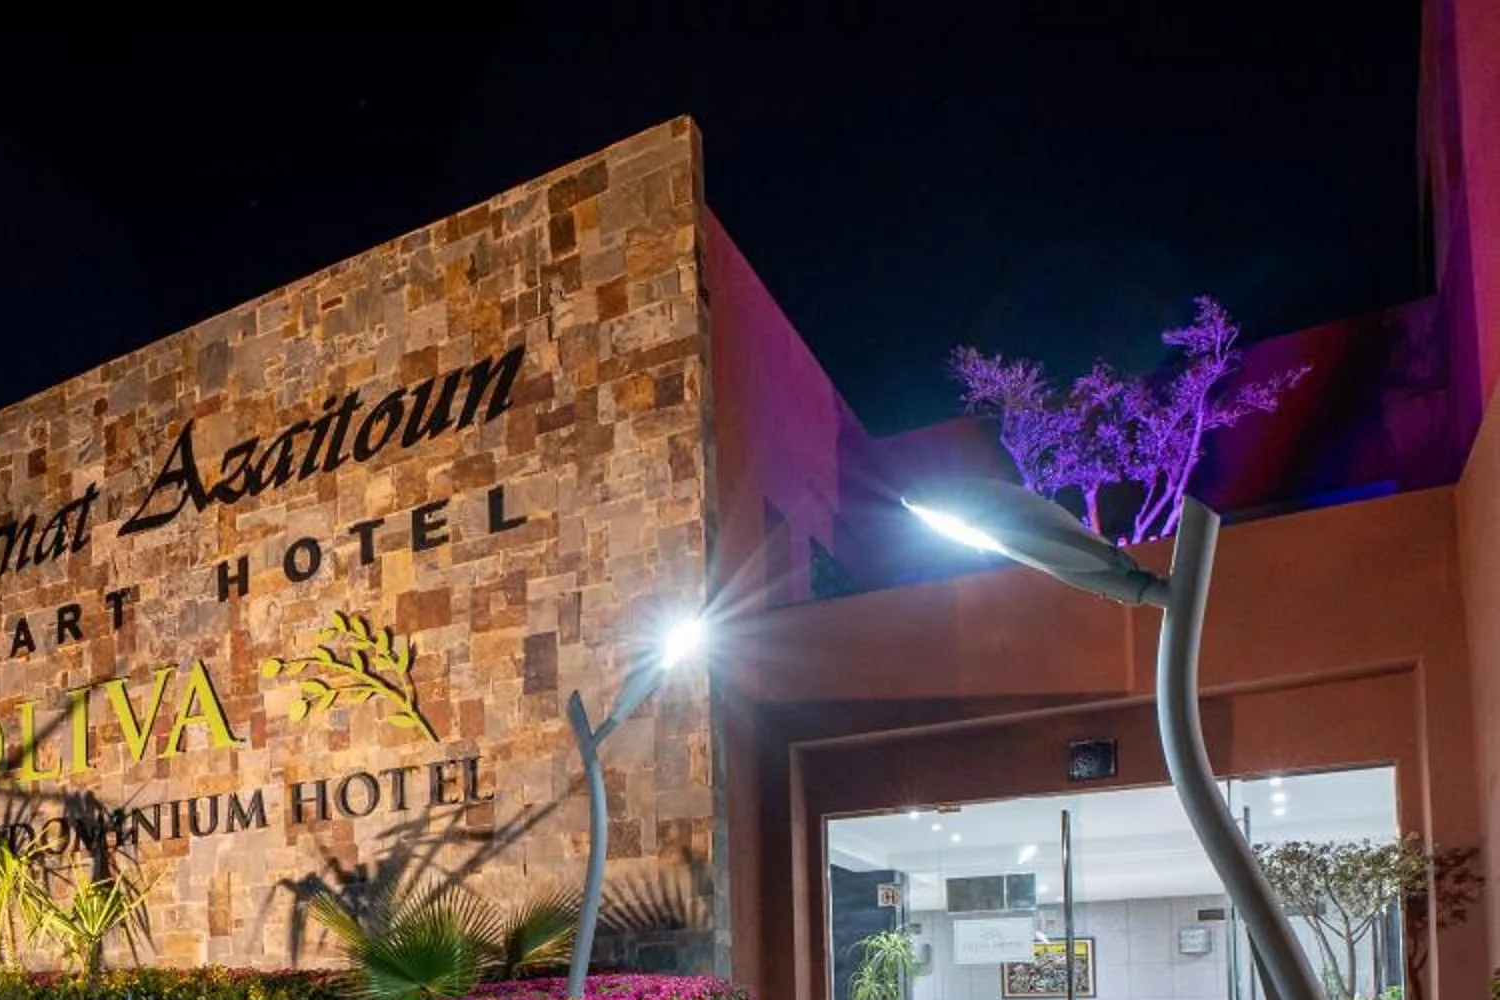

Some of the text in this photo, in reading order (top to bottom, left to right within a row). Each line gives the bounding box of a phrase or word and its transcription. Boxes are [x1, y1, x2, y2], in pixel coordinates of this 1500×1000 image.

[117, 345, 525, 536] Azaitoun
[217, 486, 529, 602] HOTEL
[291, 756, 495, 823] HOTEL
